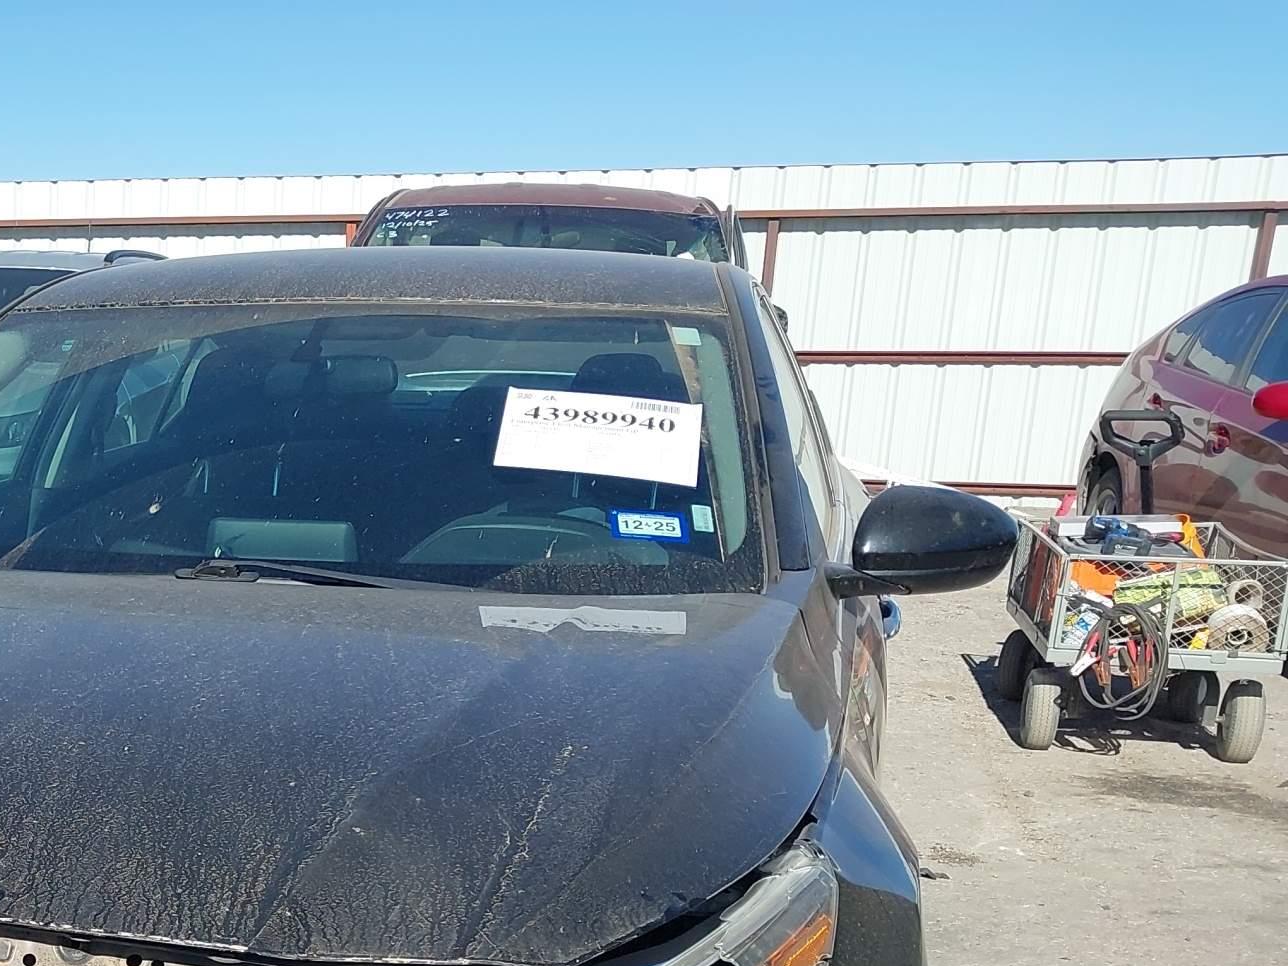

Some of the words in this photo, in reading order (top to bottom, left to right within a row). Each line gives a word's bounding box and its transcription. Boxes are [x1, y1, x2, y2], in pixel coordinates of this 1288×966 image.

[523, 405, 676, 433] 43989940
[621, 519, 644, 530] 12
[654, 520, 676, 532] 25
